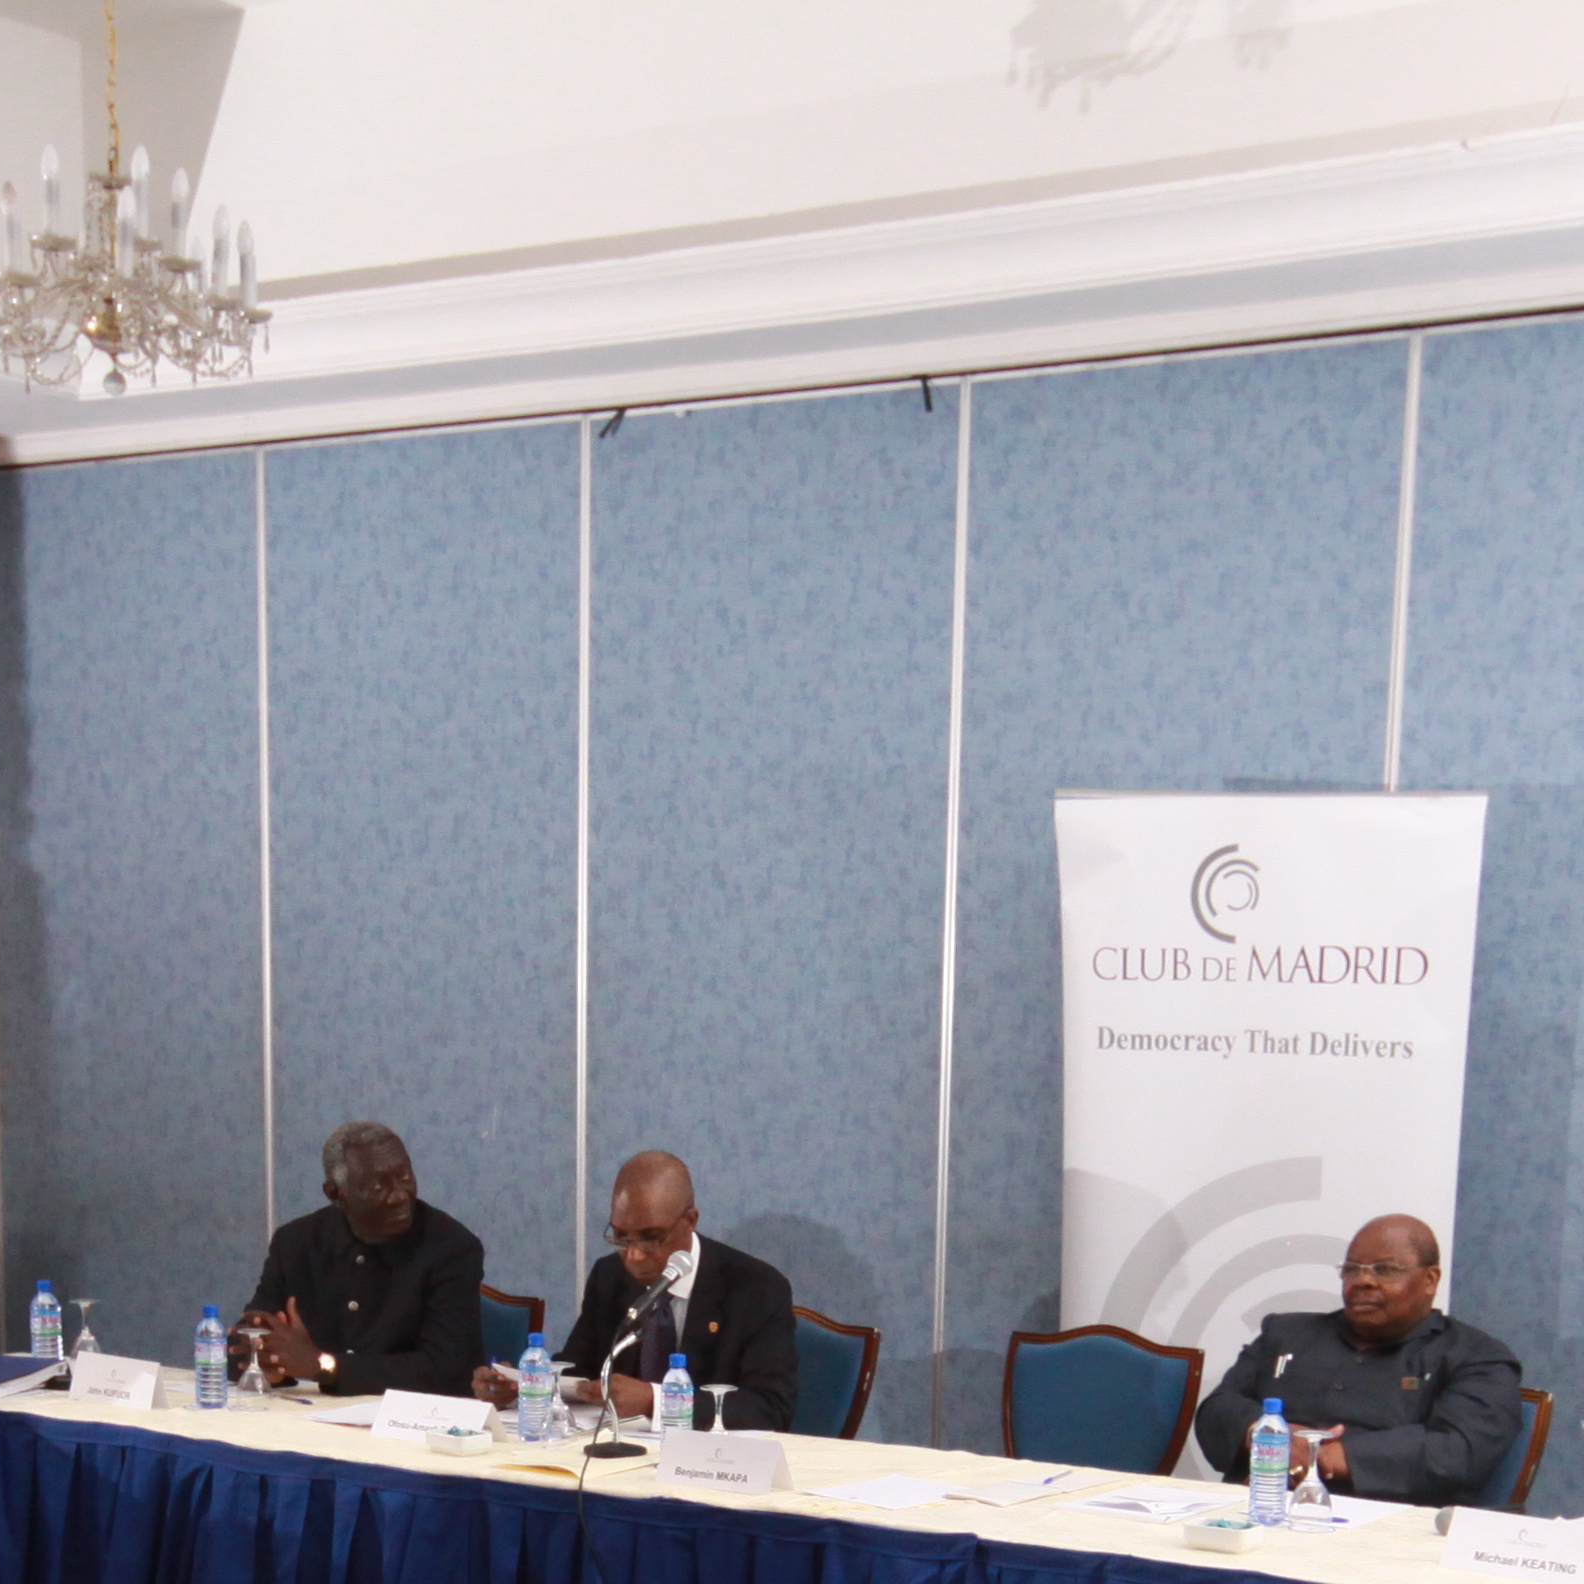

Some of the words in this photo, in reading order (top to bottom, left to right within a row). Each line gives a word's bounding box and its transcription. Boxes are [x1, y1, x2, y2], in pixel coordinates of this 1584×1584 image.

[1092, 946, 1192, 983] CLUB
[1201, 956, 1238, 982] DE
[1247, 944, 1429, 985] MADRID
[1096, 1026, 1236, 1058] Democracy
[1244, 1029, 1300, 1055] That
[1309, 1031, 1414, 1059] Delivers
[674, 1466, 714, 1479] Benjamin
[716, 1471, 749, 1483] MKAPA
[1473, 1550, 1518, 1567] Michael
[1521, 1557, 1578, 1575] KEATING
